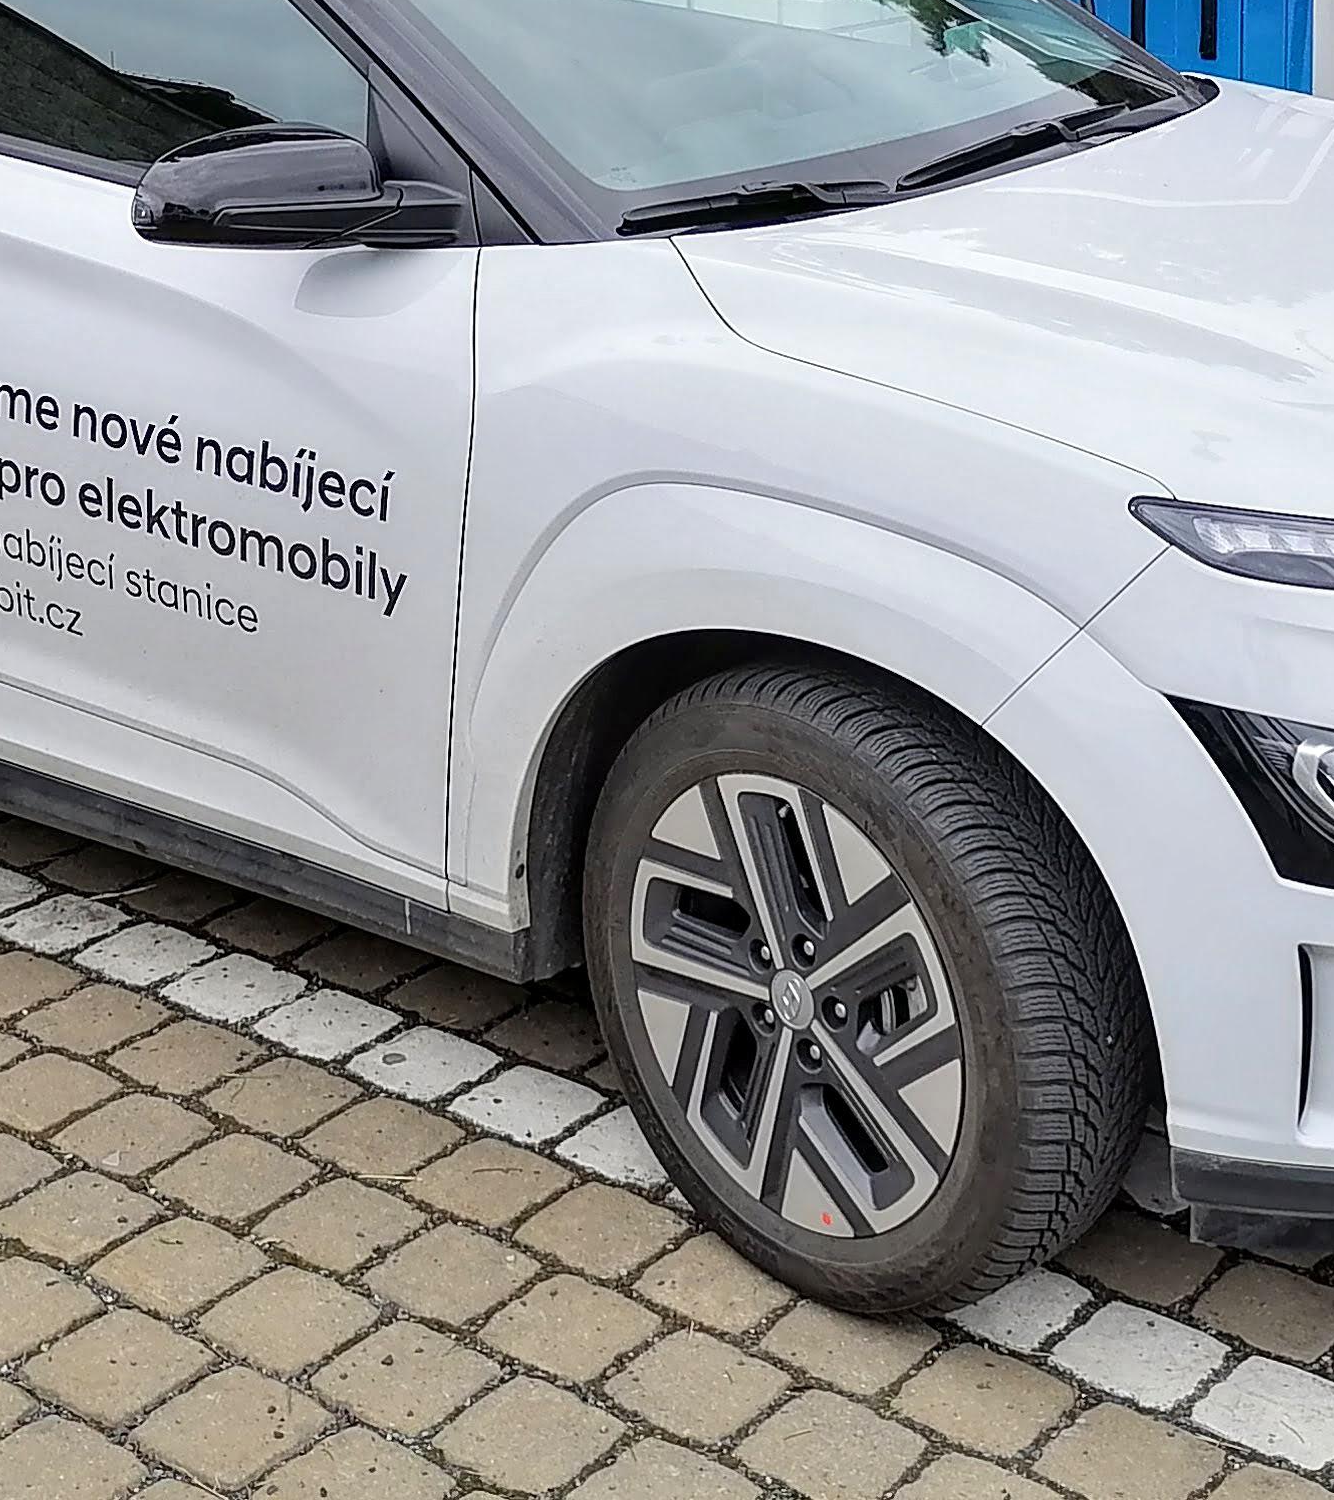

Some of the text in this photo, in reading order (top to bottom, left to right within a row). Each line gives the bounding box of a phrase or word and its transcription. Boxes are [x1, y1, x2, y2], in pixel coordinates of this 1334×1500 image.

[73, 400, 182, 464] nové
[195, 436, 396, 521] nabíjecí
[78, 477, 408, 618] elektromobily
[125, 567, 259, 633] stanice
